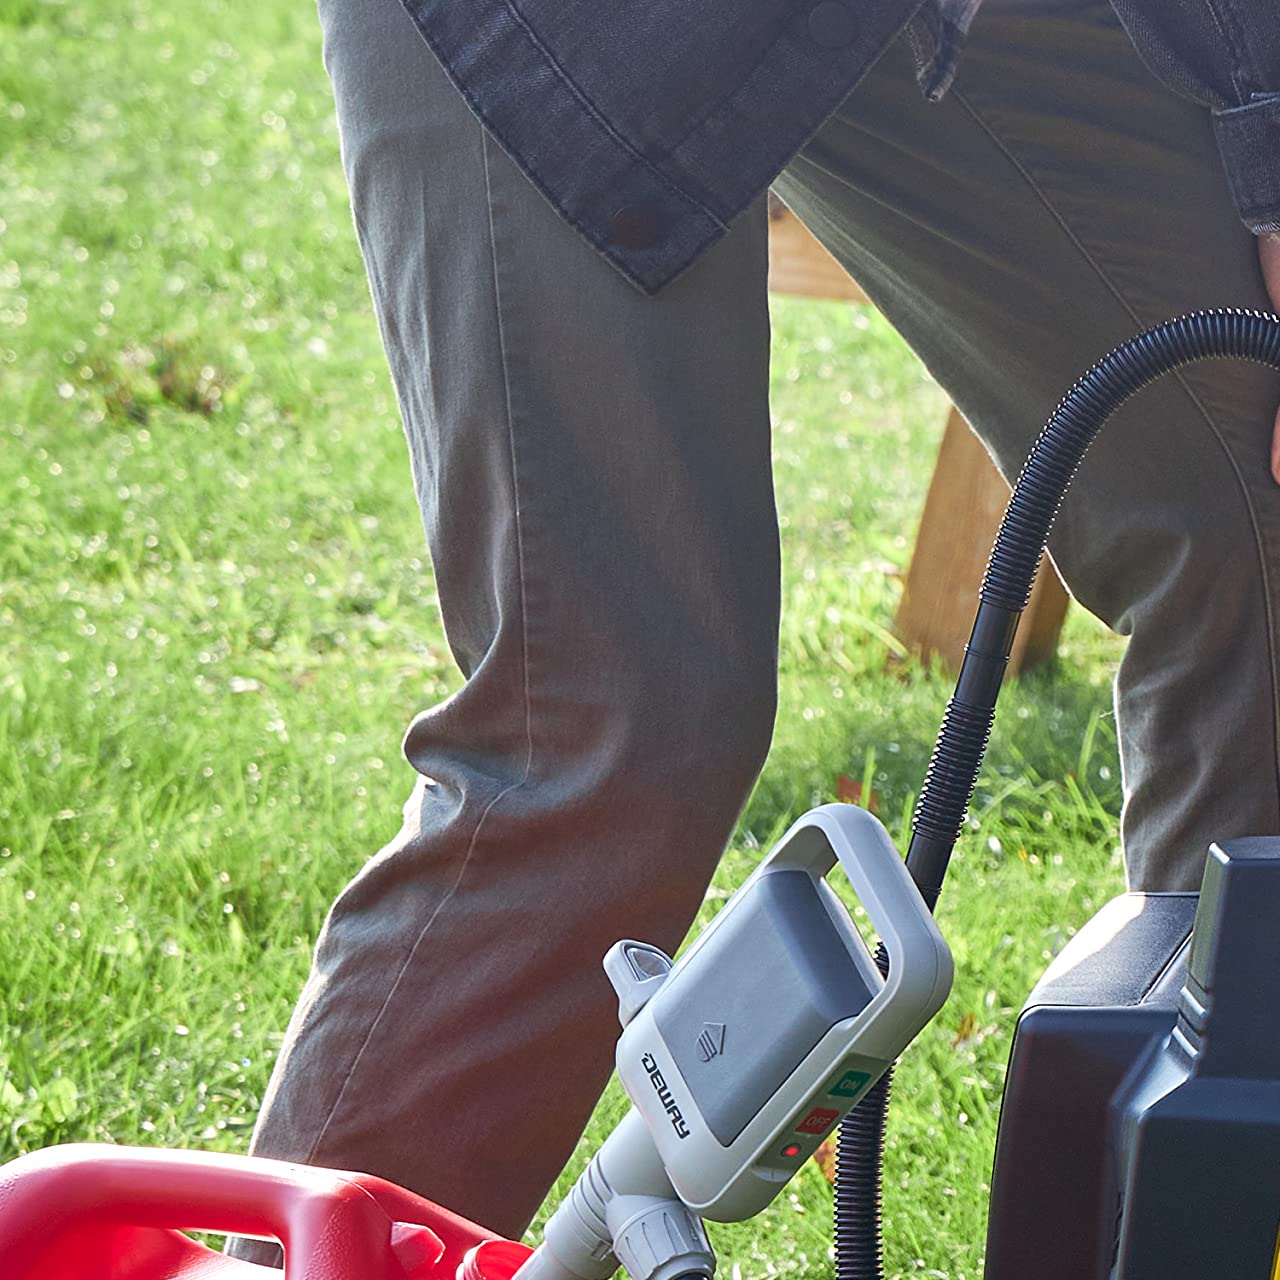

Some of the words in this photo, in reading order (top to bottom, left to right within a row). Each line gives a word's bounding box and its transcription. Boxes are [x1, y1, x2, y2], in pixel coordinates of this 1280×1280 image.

[841, 1079, 861, 1088] ON
[641, 1052, 691, 1140] DEWAY
[806, 1116, 832, 1127] OFF
